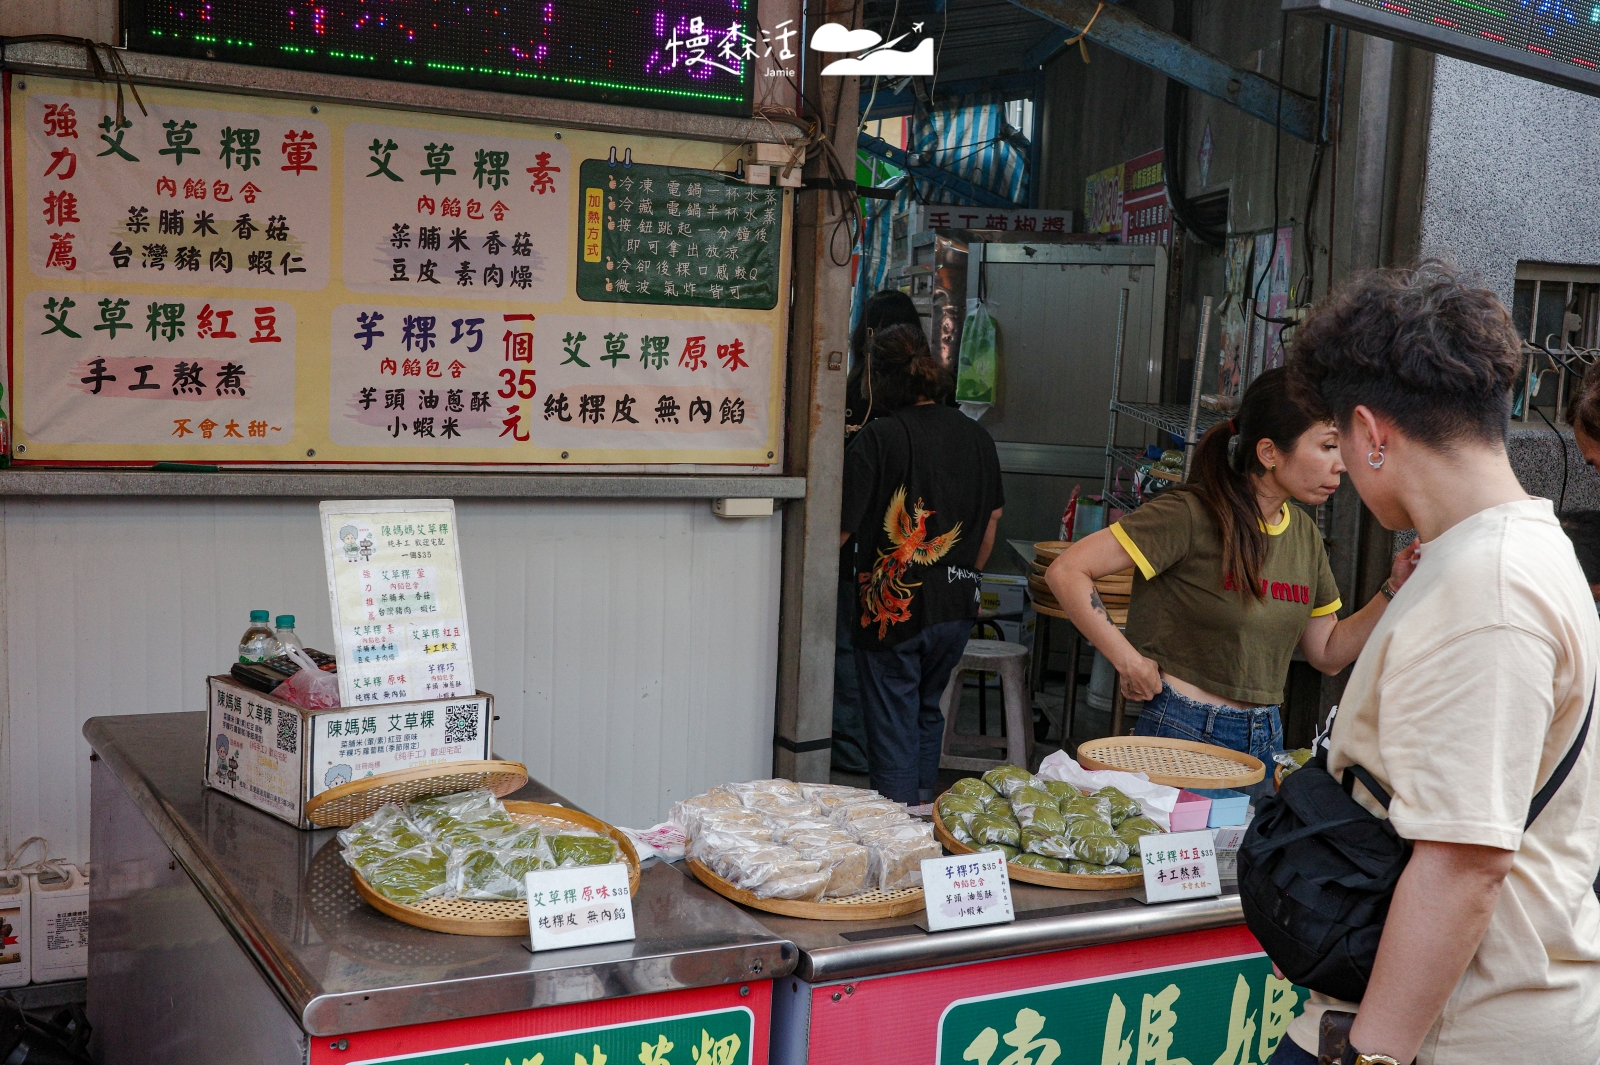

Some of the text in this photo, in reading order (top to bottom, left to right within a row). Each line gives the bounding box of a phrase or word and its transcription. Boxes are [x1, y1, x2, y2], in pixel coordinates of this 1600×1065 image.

[42, 103, 81, 271] 強力推薦
[155, 175, 262, 204] 內餡包含
[417, 195, 510, 222] 內餡包含
[586, 194, 600, 257] 加熱方式
[353, 311, 486, 353] 芋粿巧
[80, 356, 247, 396] 手工熬煮
[380, 357, 467, 378] 內餡包含
[387, 416, 462, 439] 小蝦米
[327, 710, 435, 738] 陳媽媽 艾草粿
[953, 878, 985, 888] 內餡包含
[1157, 866, 1201, 882] 手工熬煮
[958, 905, 984, 917] 小蝦米
